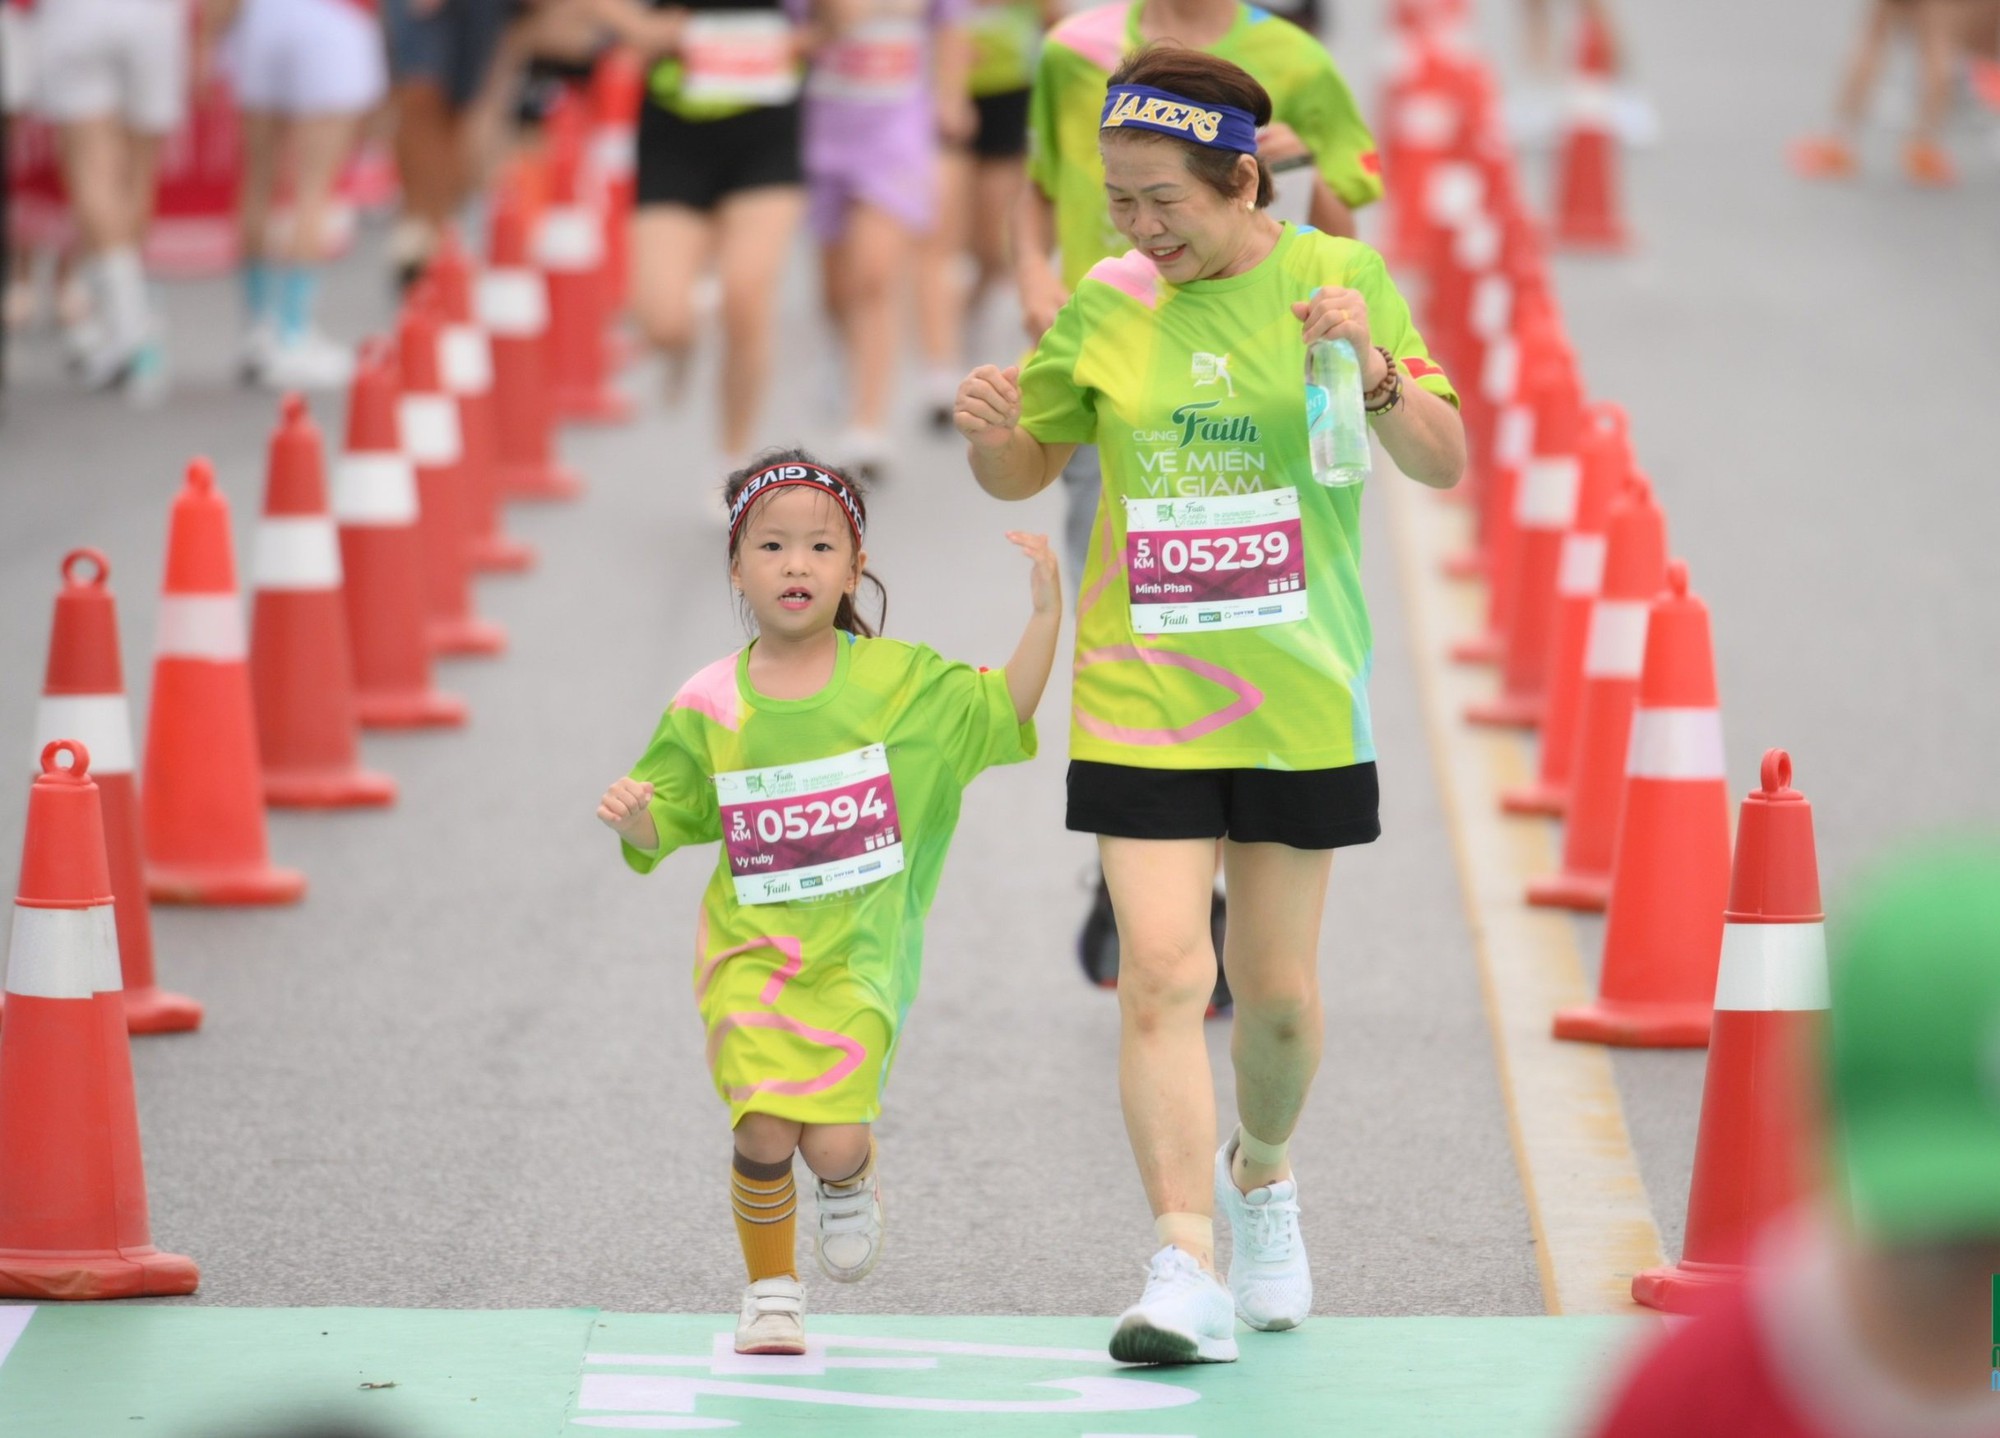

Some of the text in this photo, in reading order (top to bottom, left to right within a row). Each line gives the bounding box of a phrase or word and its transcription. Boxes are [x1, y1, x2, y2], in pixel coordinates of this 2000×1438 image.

[1102, 93, 1223, 143] LAKERS
[1172, 399, 1260, 448] Faith
[1138, 539, 1151, 557] 5
[1161, 531, 1290, 574] 05239
[1134, 557, 1154, 569] KM
[1135, 582, 1192, 594] Minh Phan
[1160, 610, 1189, 627] Faith
[732, 810, 746, 830] 5
[757, 786, 888, 844] 05294
[731, 828, 752, 842] KM
[735, 853, 774, 868] Vy ruby
[763, 878, 791, 897] Faith
